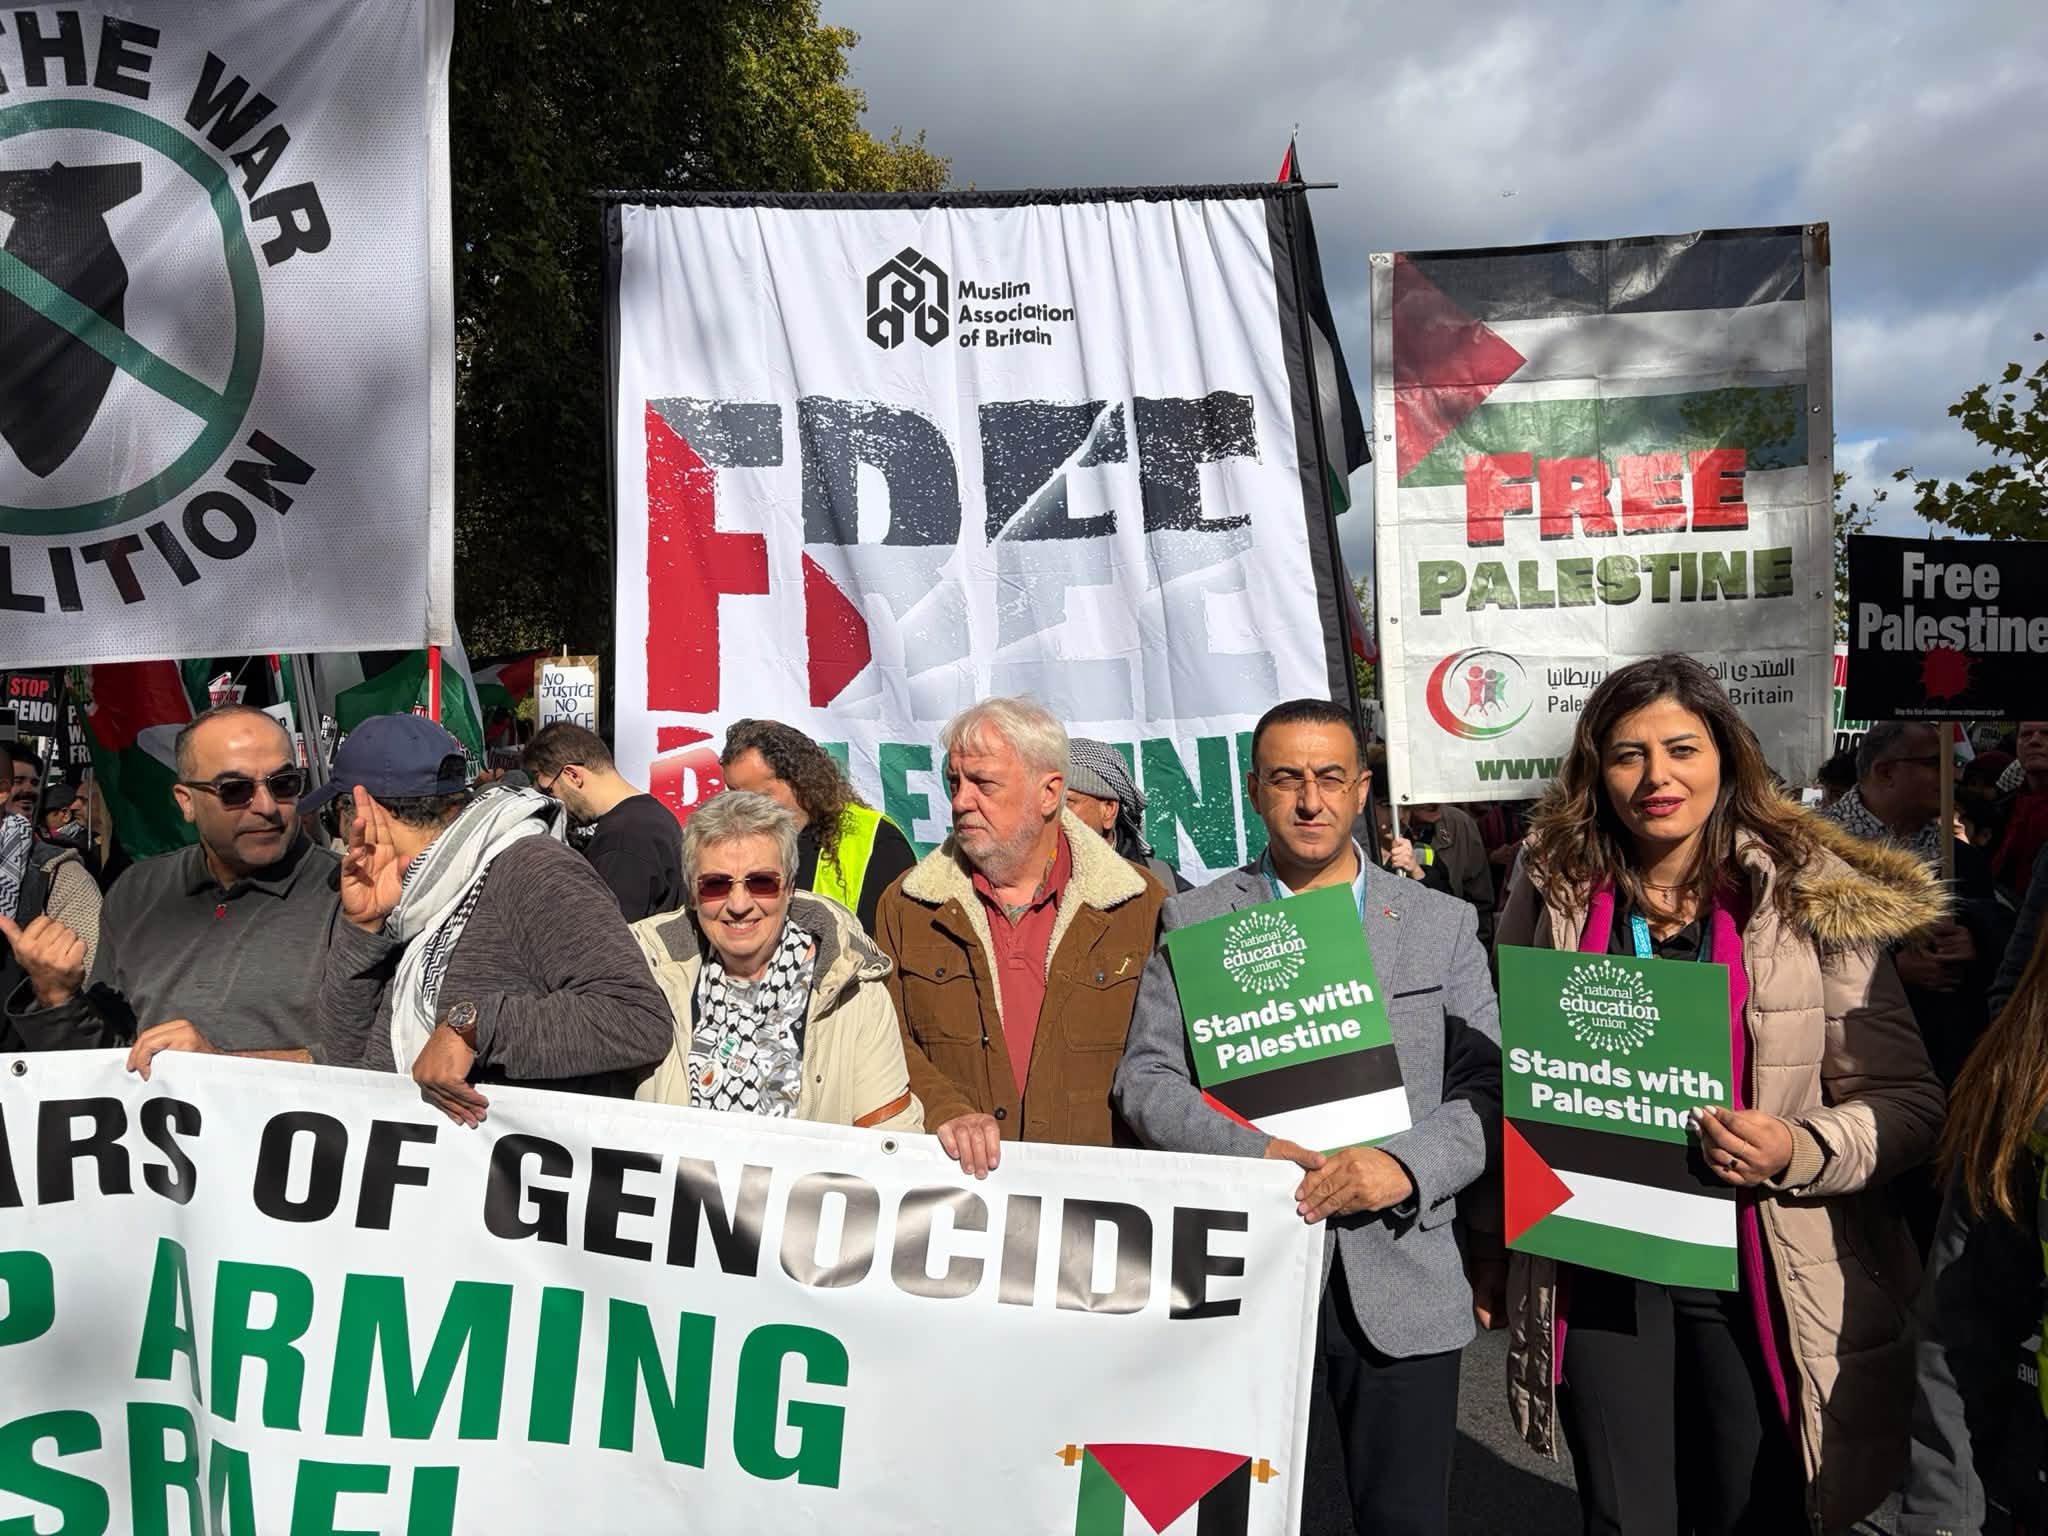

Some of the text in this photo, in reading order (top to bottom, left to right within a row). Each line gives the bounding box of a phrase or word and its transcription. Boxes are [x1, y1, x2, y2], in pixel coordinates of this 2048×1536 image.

[0, 11, 332, 268] HE WAR
[958, 280, 1031, 300] Muslim
[958, 302, 1075, 324] Association
[959, 325, 1052, 348] of Britain
[1464, 447, 1749, 548] FREE
[646, 390, 1282, 723] FREE
[1417, 546, 1794, 616] PALESTINE
[1902, 551, 2001, 600] Free
[1858, 602, 2048, 653] Palestine
[9, 676, 49, 698] STOP
[544, 673, 564, 686] NO
[1728, 685, 1794, 705] Britain
[555, 698, 577, 712] NO
[1223, 936, 1307, 970] education
[1240, 930, 1281, 948] national
[1251, 957, 1283, 974] union
[1559, 993, 1661, 1021] education
[1583, 985, 1633, 1000] national
[1193, 980, 1374, 1043] Stands with
[1591, 1016, 1628, 1030] union
[1216, 1018, 1361, 1070] Palestine
[1509, 1047, 1725, 1101] Stands with
[253, 1110, 438, 1230] OF
[483, 1133, 1249, 1321] GENOCIDE
[135, 1237, 850, 1490] ARMING
